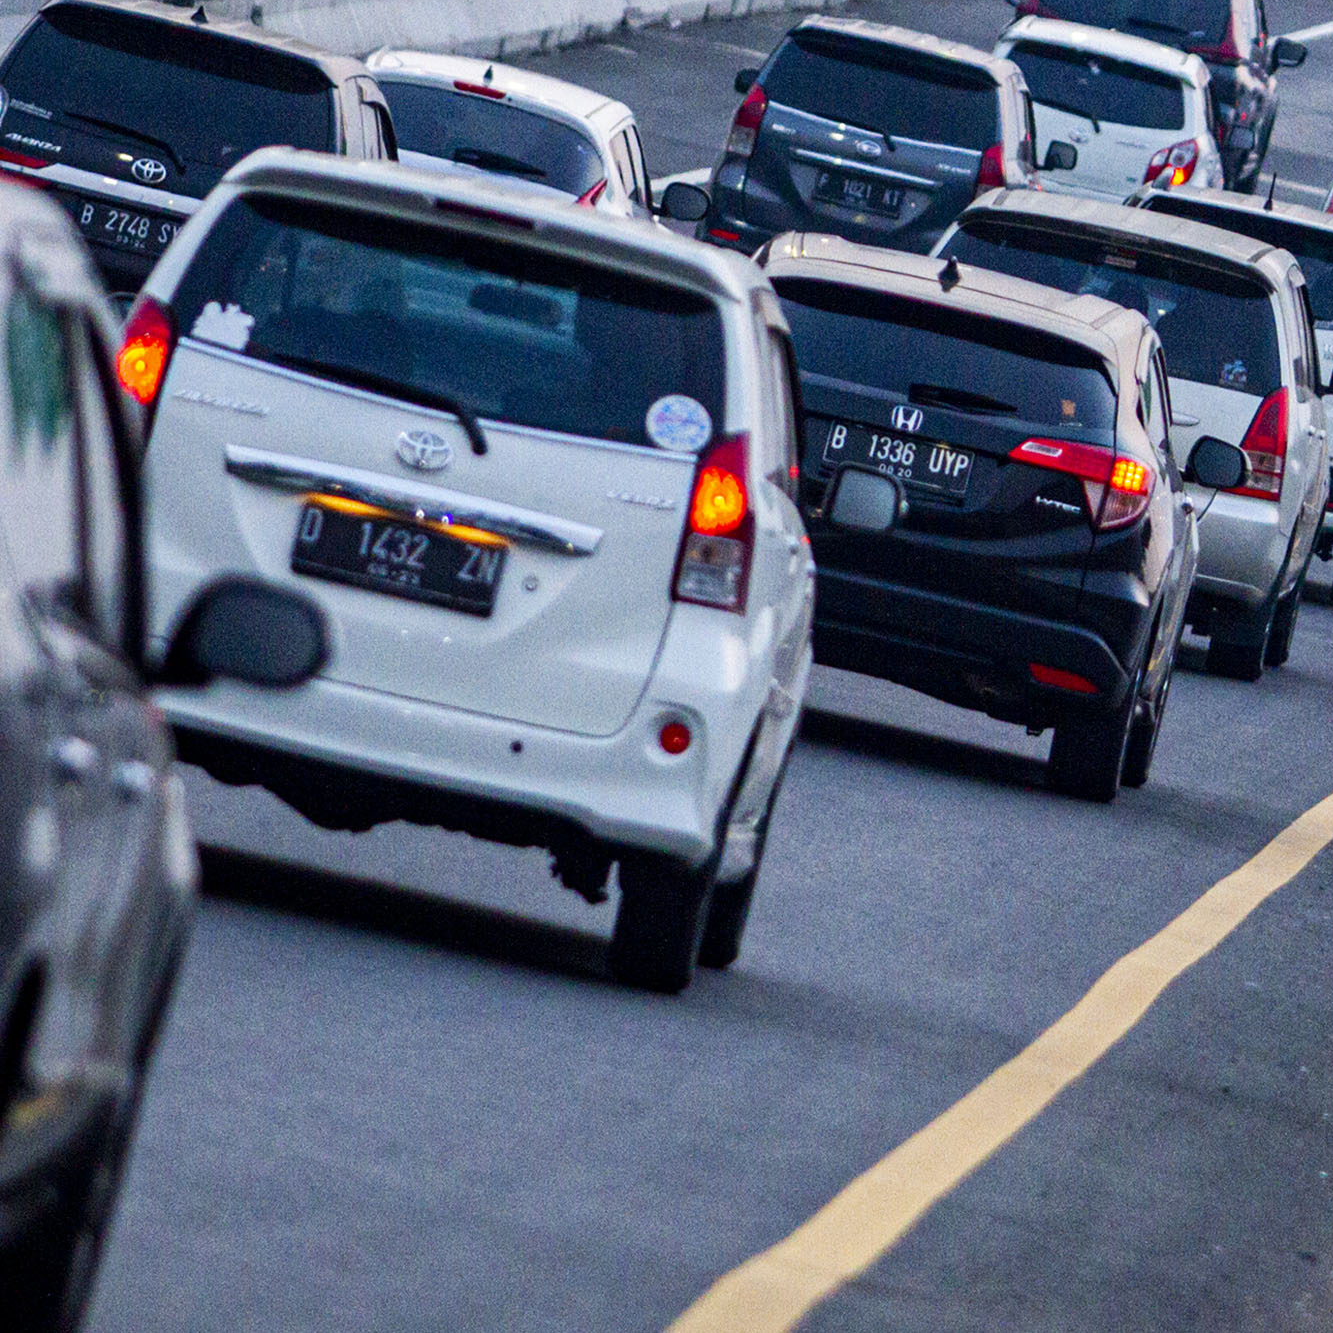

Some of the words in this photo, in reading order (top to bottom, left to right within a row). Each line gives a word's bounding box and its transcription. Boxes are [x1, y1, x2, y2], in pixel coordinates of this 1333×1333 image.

[81, 203, 95, 225] B
[105, 210, 151, 239] 2748
[829, 424, 847, 451] B
[867, 434, 916, 467] 1336
[928, 446, 970, 478] UYP
[300, 507, 324, 543] D
[359, 520, 431, 570] 1432
[456, 544, 500, 585] ZN
